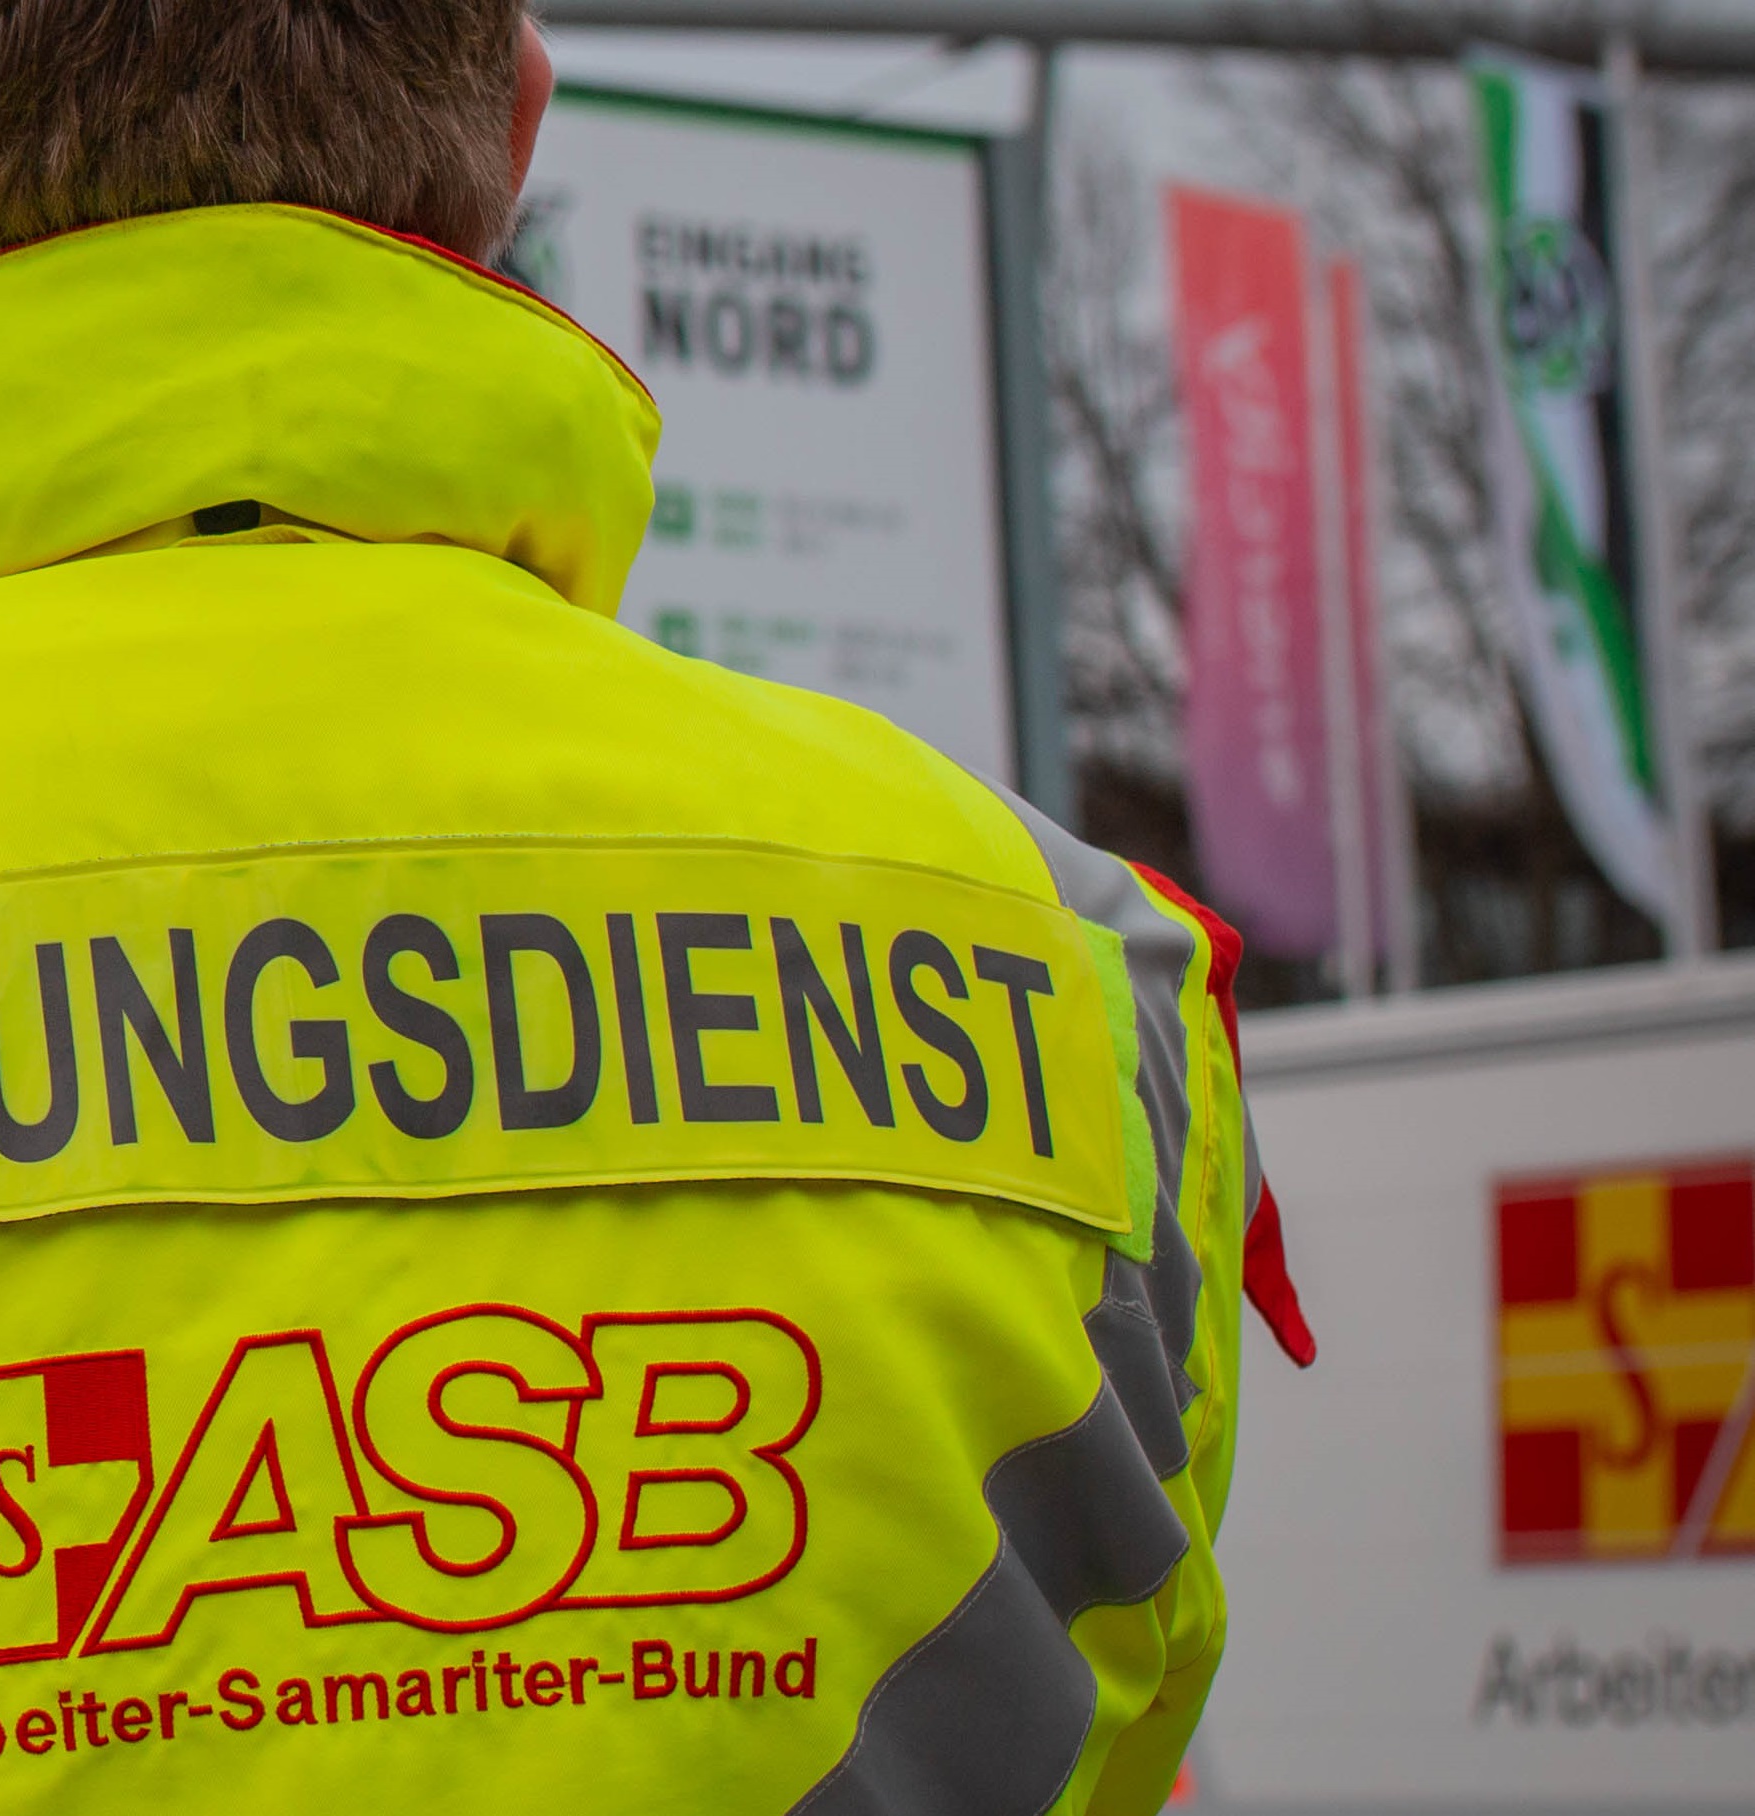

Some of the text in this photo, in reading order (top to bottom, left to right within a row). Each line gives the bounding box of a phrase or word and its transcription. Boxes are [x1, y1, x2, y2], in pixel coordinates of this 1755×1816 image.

[640, 216, 868, 286] EINGANG
[640, 290, 877, 388] NORD
[78, 1302, 822, 1658] ASB
